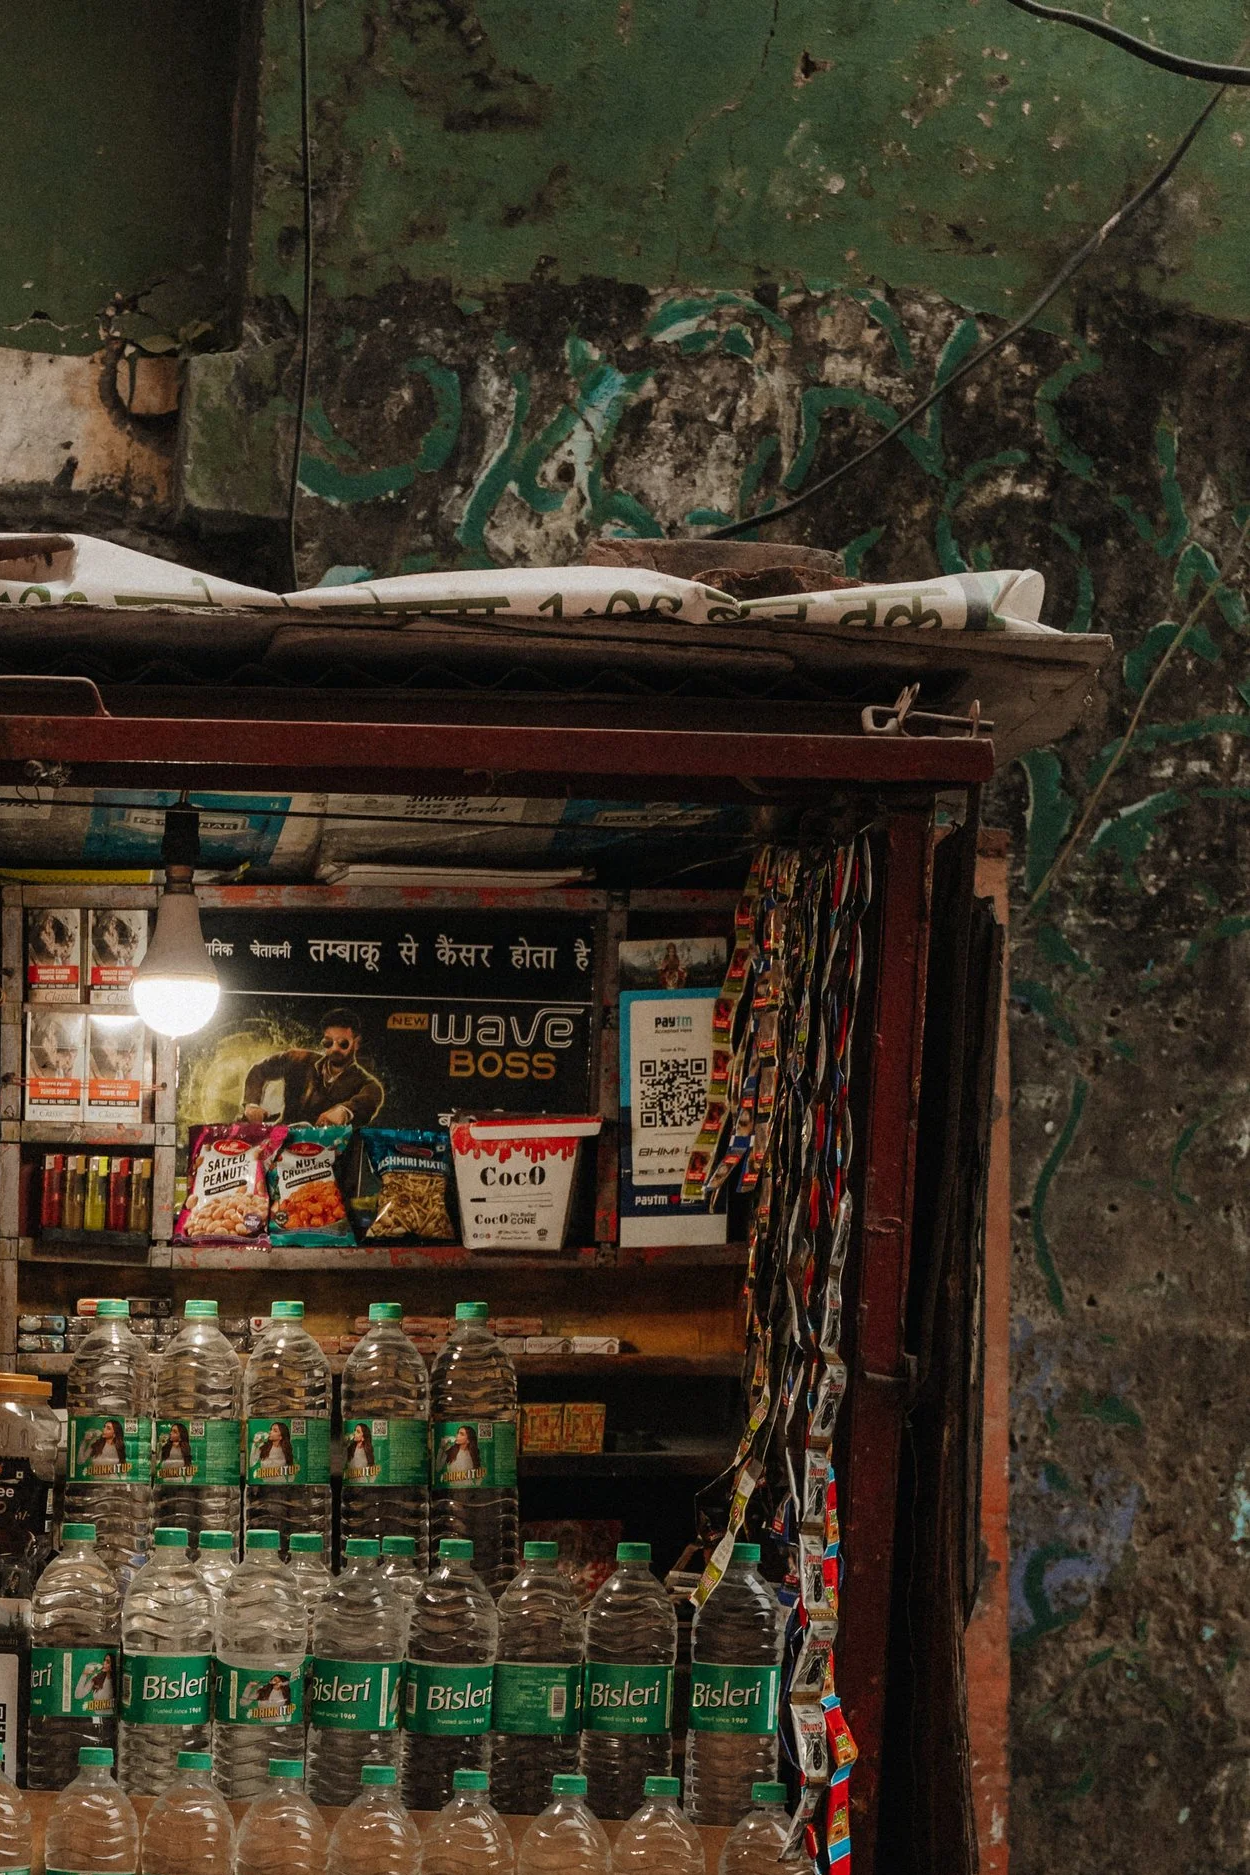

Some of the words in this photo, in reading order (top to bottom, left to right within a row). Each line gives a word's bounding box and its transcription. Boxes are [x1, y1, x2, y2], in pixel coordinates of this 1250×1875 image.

[250, 938, 291, 958] चेतावनी
[308, 939, 382, 972] तम्बाकू
[398, 934, 419, 965] से
[435, 933, 493, 968] कैंसर
[509, 937, 557, 969] होता
[574, 938, 591, 972] है
[391, 1015, 427, 1027] NEW
[431, 1008, 585, 1048] wave
[450, 1050, 557, 1079] BOSS
[295, 1157, 317, 1169] NUT
[510, 1217, 537, 1225] CONE
[141, 1671, 209, 1702] Bisleri
[425, 1679, 492, 1712] Bisleri
[589, 1679, 661, 1710] Bisleri
[692, 1677, 762, 1710] Bisleri
[340, 1712, 357, 1720] 1969
[631, 1715, 649, 1724] 1969
[732, 1715, 749, 1724] 1969
